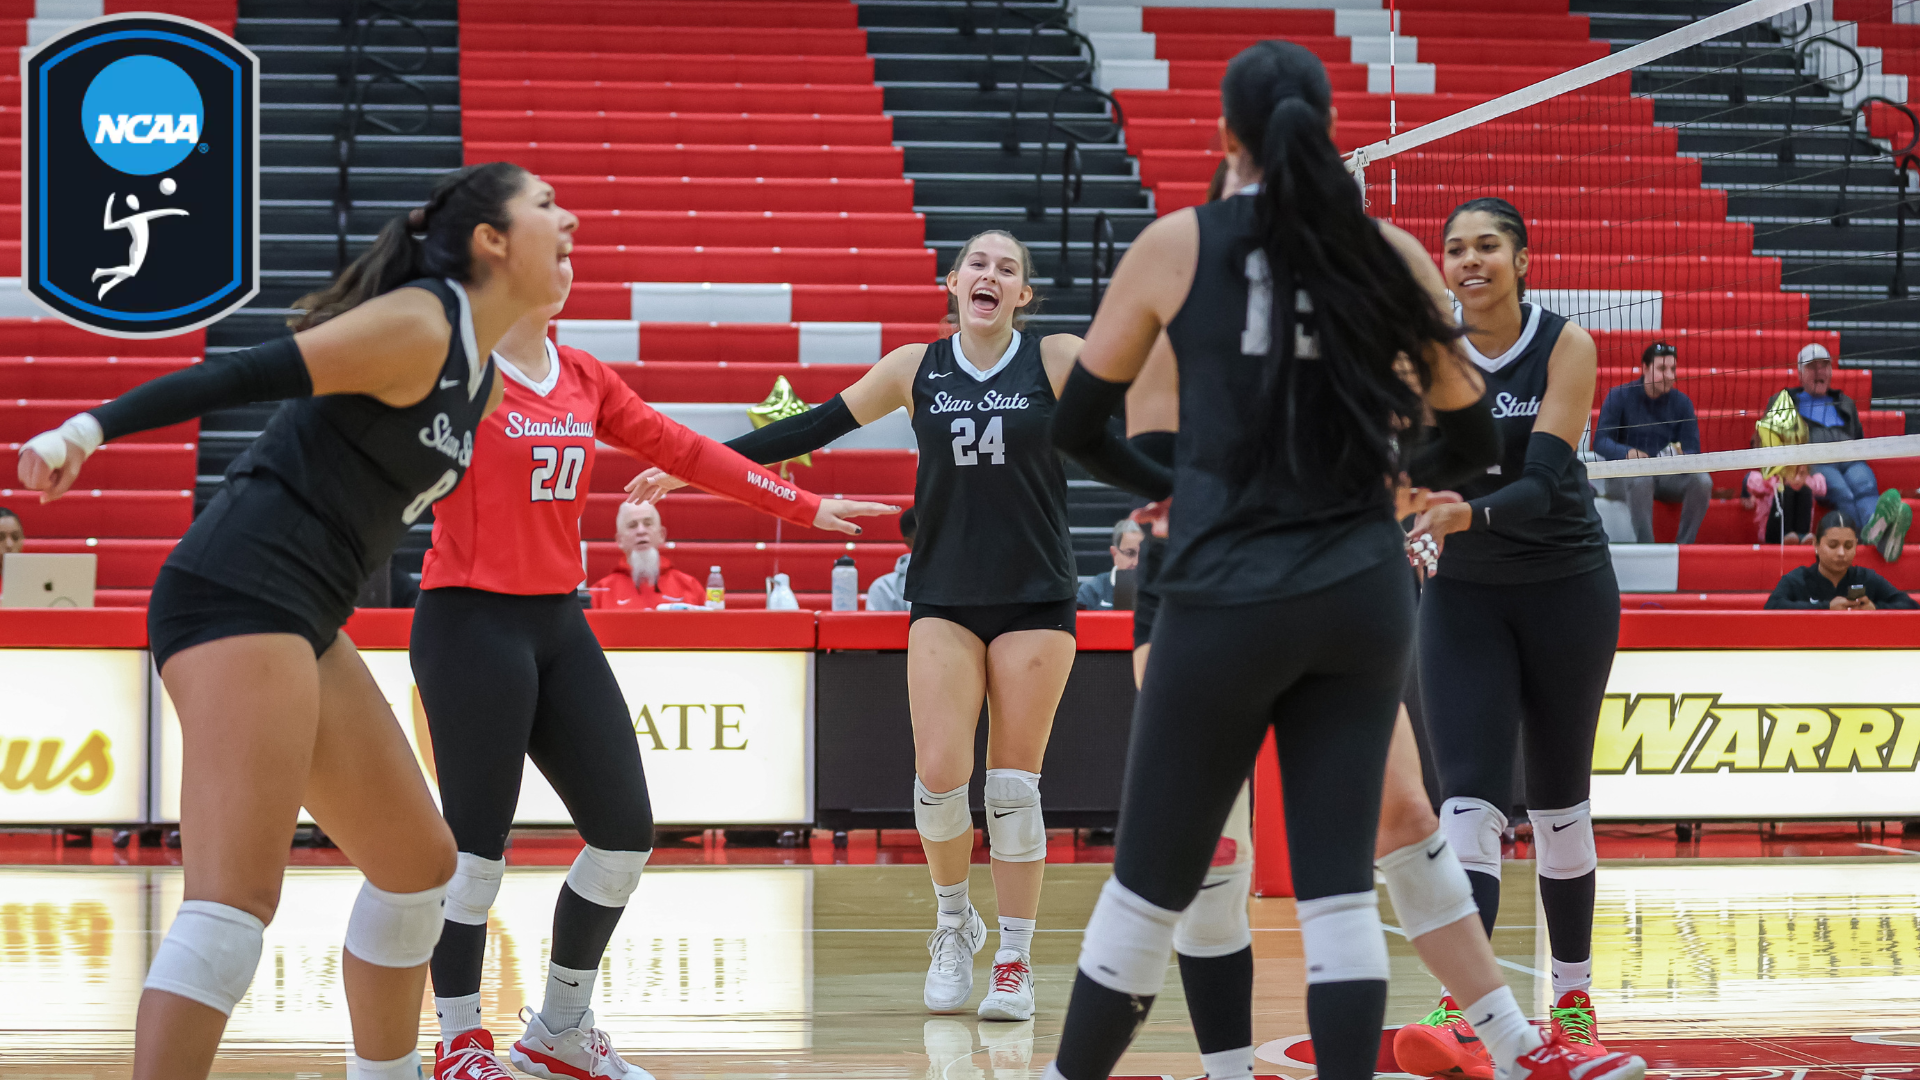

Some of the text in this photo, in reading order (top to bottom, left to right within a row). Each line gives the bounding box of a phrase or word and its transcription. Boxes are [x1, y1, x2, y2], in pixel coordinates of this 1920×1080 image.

[505, 411, 594, 438] Stanislaus
[930, 390, 1029, 414] Stan State
[950, 416, 1005, 466] 24
[530, 446, 586, 502] 20
[747, 470, 797, 502] WARRIORS
[634, 703, 749, 751] ATE
[0, 730, 114, 795] us
